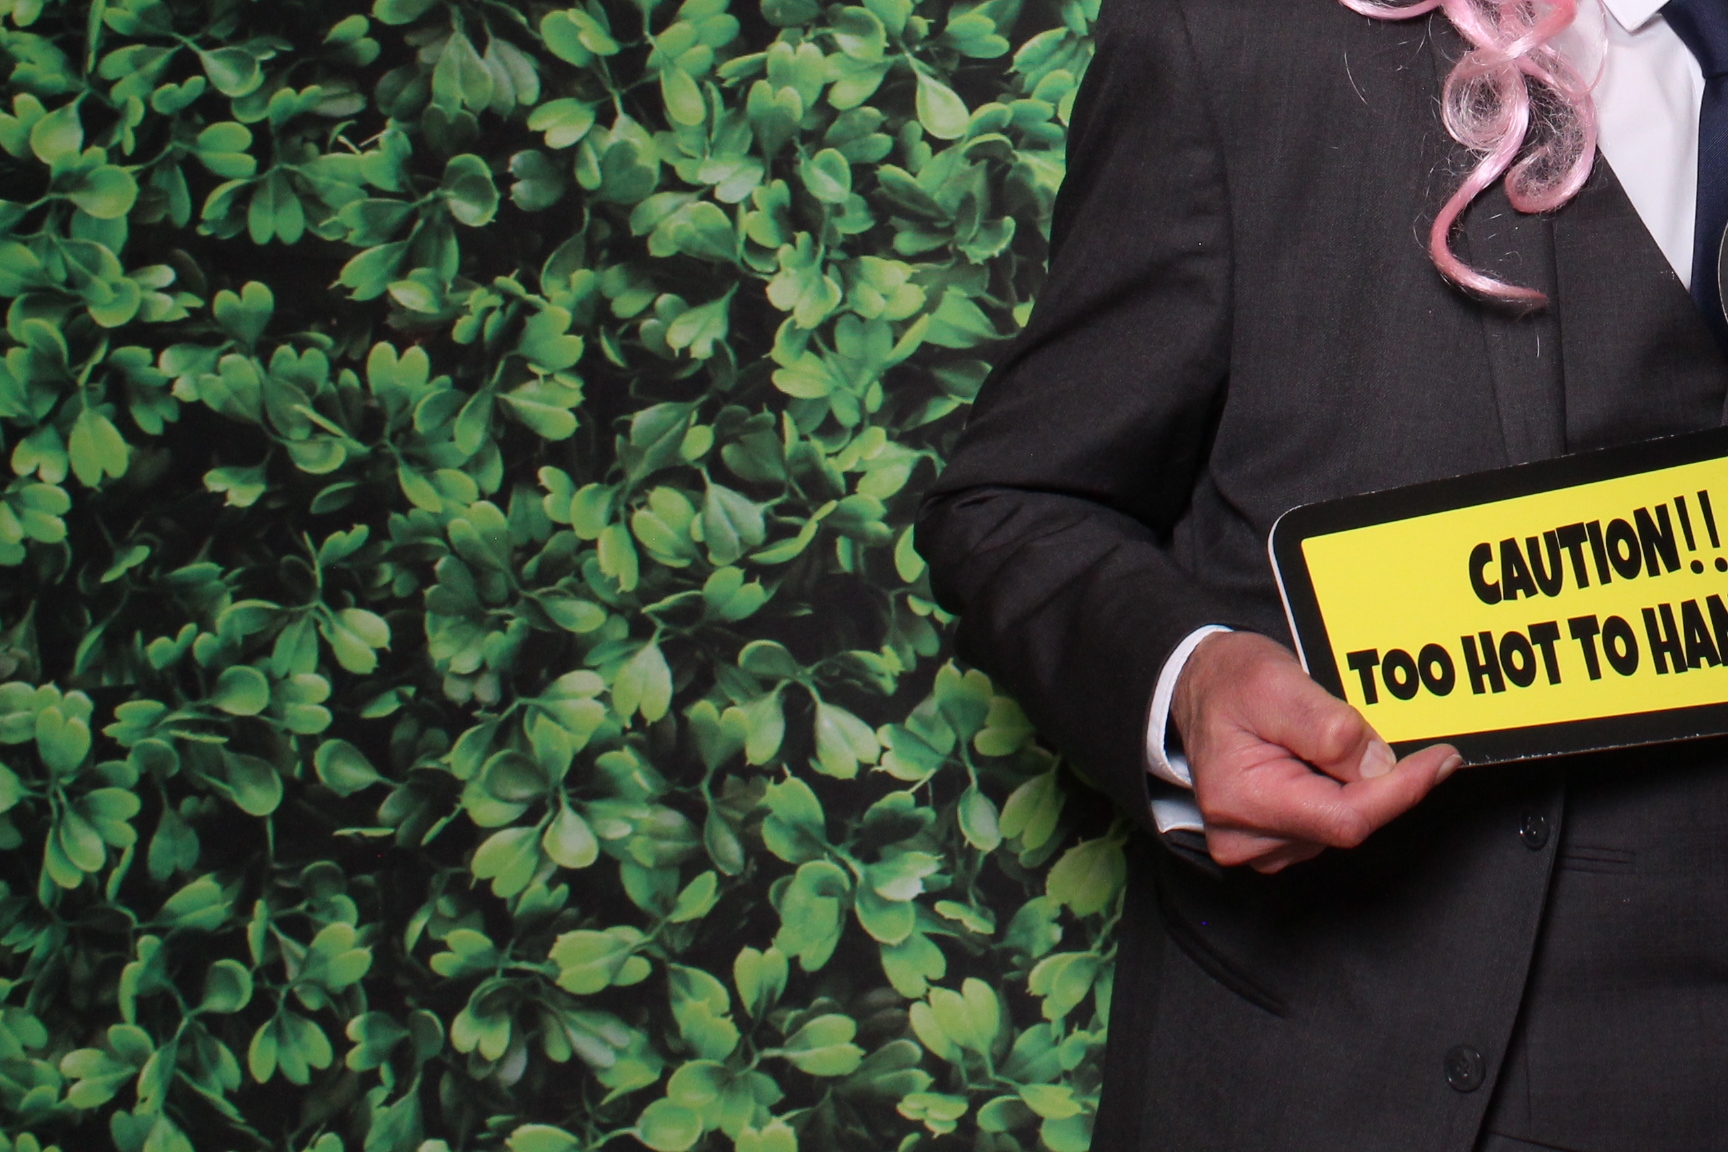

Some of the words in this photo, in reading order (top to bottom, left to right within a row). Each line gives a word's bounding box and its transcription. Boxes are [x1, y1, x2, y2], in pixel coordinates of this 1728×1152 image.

[1468, 489, 1728, 605] CAUTION!!
[1346, 643, 1456, 705] TOO
[1460, 621, 1562, 695] HOT
[1567, 615, 1639, 681] TO
